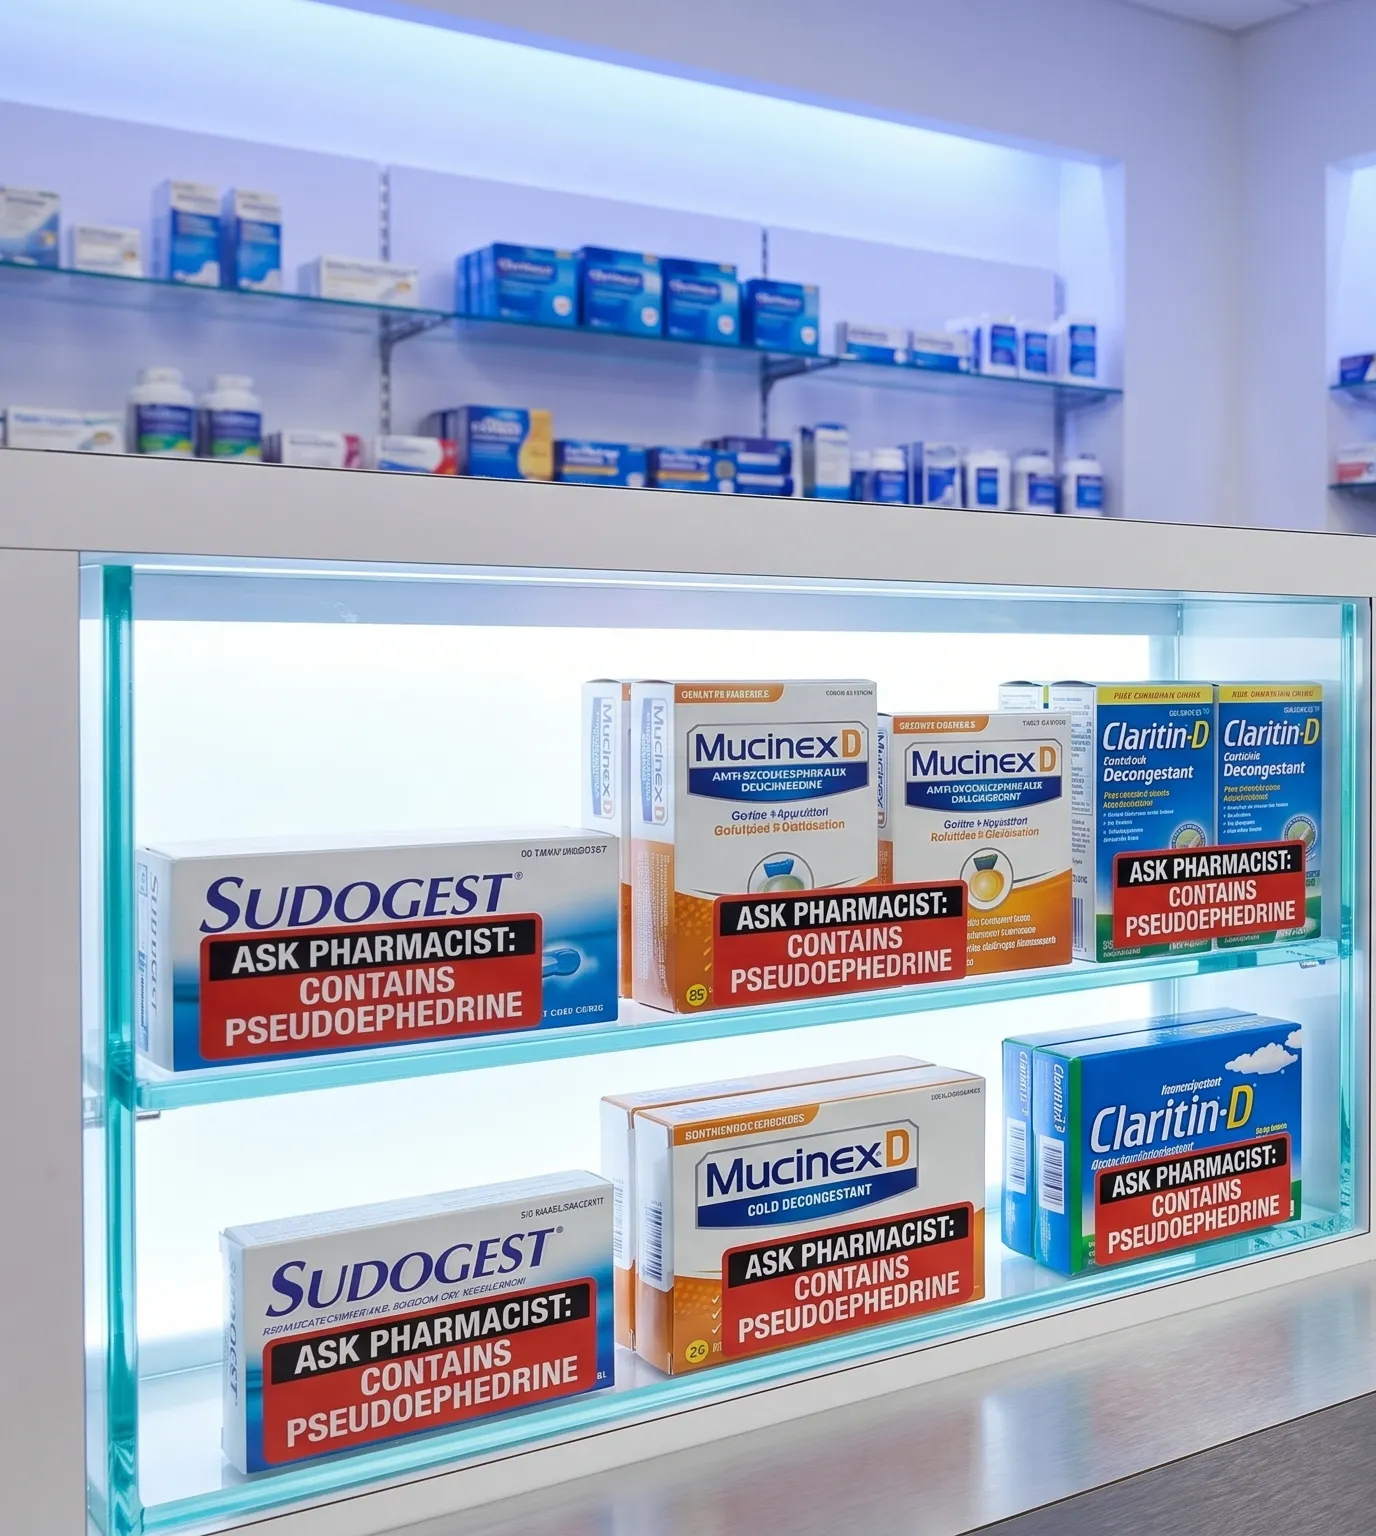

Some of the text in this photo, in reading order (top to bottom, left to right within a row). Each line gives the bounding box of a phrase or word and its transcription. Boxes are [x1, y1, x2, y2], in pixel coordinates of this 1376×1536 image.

[1102, 720, 1210, 751] Claritin-D
[1224, 718, 1320, 747] Claritin-D
[1103, 766, 1194, 785] Decongestant
[1223, 761, 1306, 780] Decongestant
[1129, 849, 1292, 883] ASK PHARMACIST:
[736, 902, 787, 931] ASK
[794, 891, 947, 926] PHARMACIST:
[1168, 879, 1257, 907] CONTAINS
[1126, 900, 1296, 937] PSEUDOEPHEDRINE
[231, 926, 517, 975] ASK PHARMACIST:
[787, 926, 903, 958] CONTAINS
[299, 965, 456, 1006] CONTAINS
[731, 948, 952, 993] PSEUDOEPHEDRINE
[225, 991, 523, 1047] PSEUDOEPHEDRINE
[1112, 1167, 1152, 1198] ASK
[1156, 1144, 1277, 1189] PHARMACIST:
[747, 1183, 872, 1218] COLD DECONGESTANT
[1151, 1178, 1242, 1218] CONTAINS
[1108, 1194, 1280, 1254] PSEUDOEPHEDRINE
[744, 1215, 955, 1280] ASK PHARMACIST:
[794, 1254, 910, 1301] CONTAINS
[738, 1270, 960, 1344] PSEUDOEPHEDRINE
[293, 1293, 572, 1375] ASK PHARMACIST:
[360, 1339, 512, 1396] CONTAINS
[286, 1355, 579, 1447] PSEUDOEPHEDRINE
